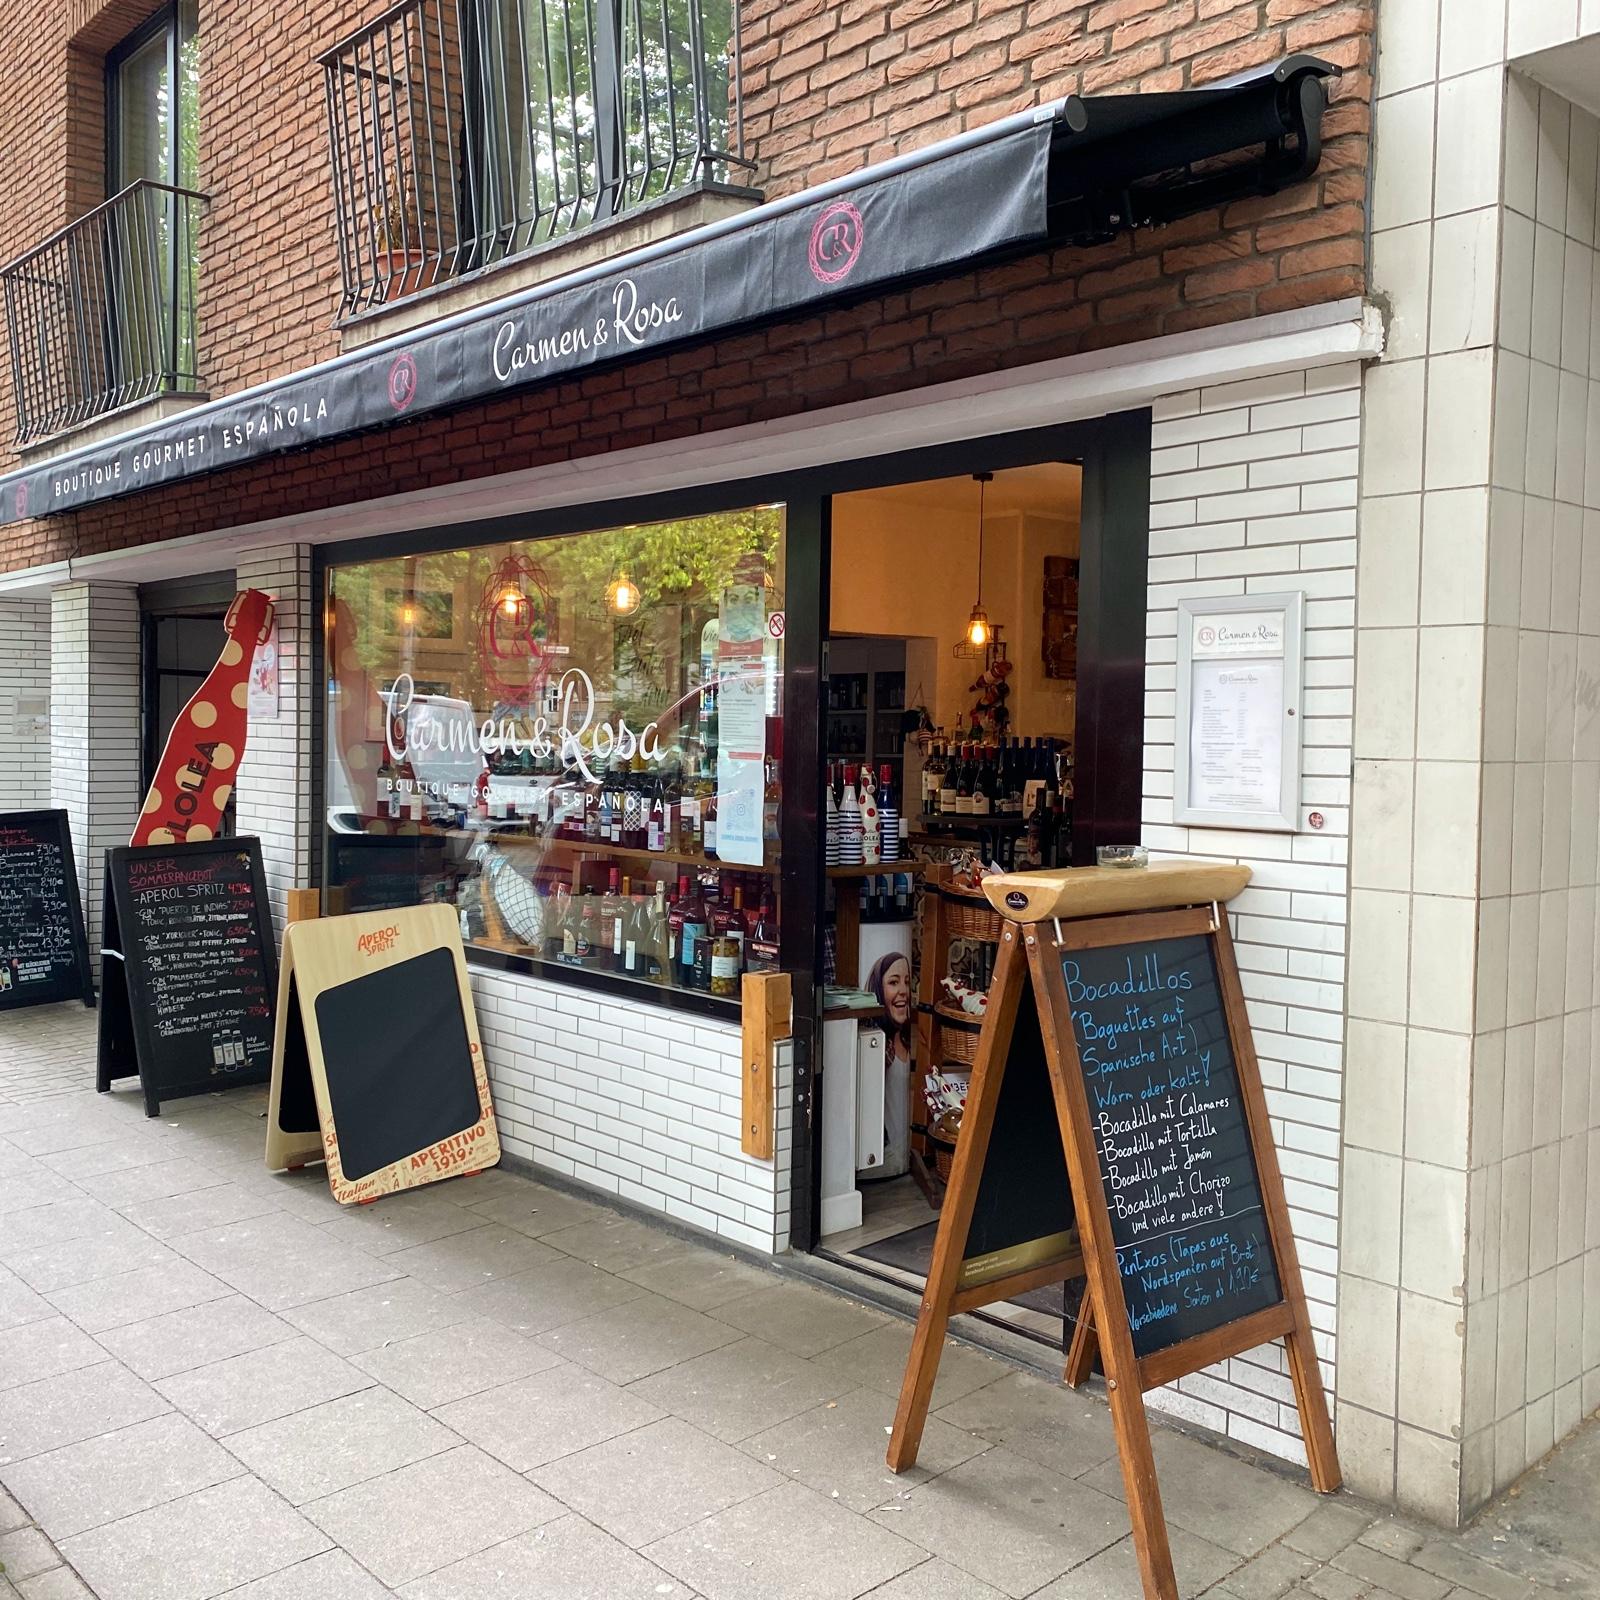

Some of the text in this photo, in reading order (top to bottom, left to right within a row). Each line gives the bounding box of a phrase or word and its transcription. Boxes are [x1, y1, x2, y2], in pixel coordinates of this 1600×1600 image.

[492, 279, 683, 381] Carmen & Rosa
[55, 398, 328, 497] BOUTIQUE GOURMET ESPAÑOLA
[386, 673, 524, 761] Carmen
[530, 717, 551, 759] &
[558, 668, 668, 785] Rosa
[167, 742, 219, 835] LOLEA
[386, 778, 459, 797] BOUTIQUE
[562, 791, 664, 813] ESPAÑOLA
[130, 859, 177, 875] UNSER
[187, 884, 225, 897] SPRITZ
[358, 923, 400, 952] APEROL
[366, 939, 395, 957] SPRITZ
[1062, 953, 1192, 1003] Bocadillos
[1162, 996, 1185, 1028] auf
[1083, 1037, 1156, 1081] Spanische
[1141, 1076, 1166, 1099] oder
[1160, 1095, 1175, 1119] mit
[1179, 1092, 1230, 1117] Calamares
[1158, 1125, 1172, 1146] mit
[1174, 1114, 1218, 1143] Tortilla
[410, 1125, 486, 1170] APERITIVO
[432, 1148, 468, 1173] 1919
[1161, 1148, 1178, 1174] mit
[1181, 1144, 1212, 1170] Jamón
[337, 1179, 376, 1202] Italian
[1168, 1175, 1186, 1202] mit
[1189, 1170, 1231, 1195] Chorizo
[1132, 1214, 1149, 1234] und
[1152, 1208, 1176, 1228] viele
[1115, 1248, 1168, 1278] Pintxos
[1209, 1232, 1230, 1249] aus
[1141, 1262, 1208, 1294] Nordspanien
[1210, 1250, 1227, 1271] auf
